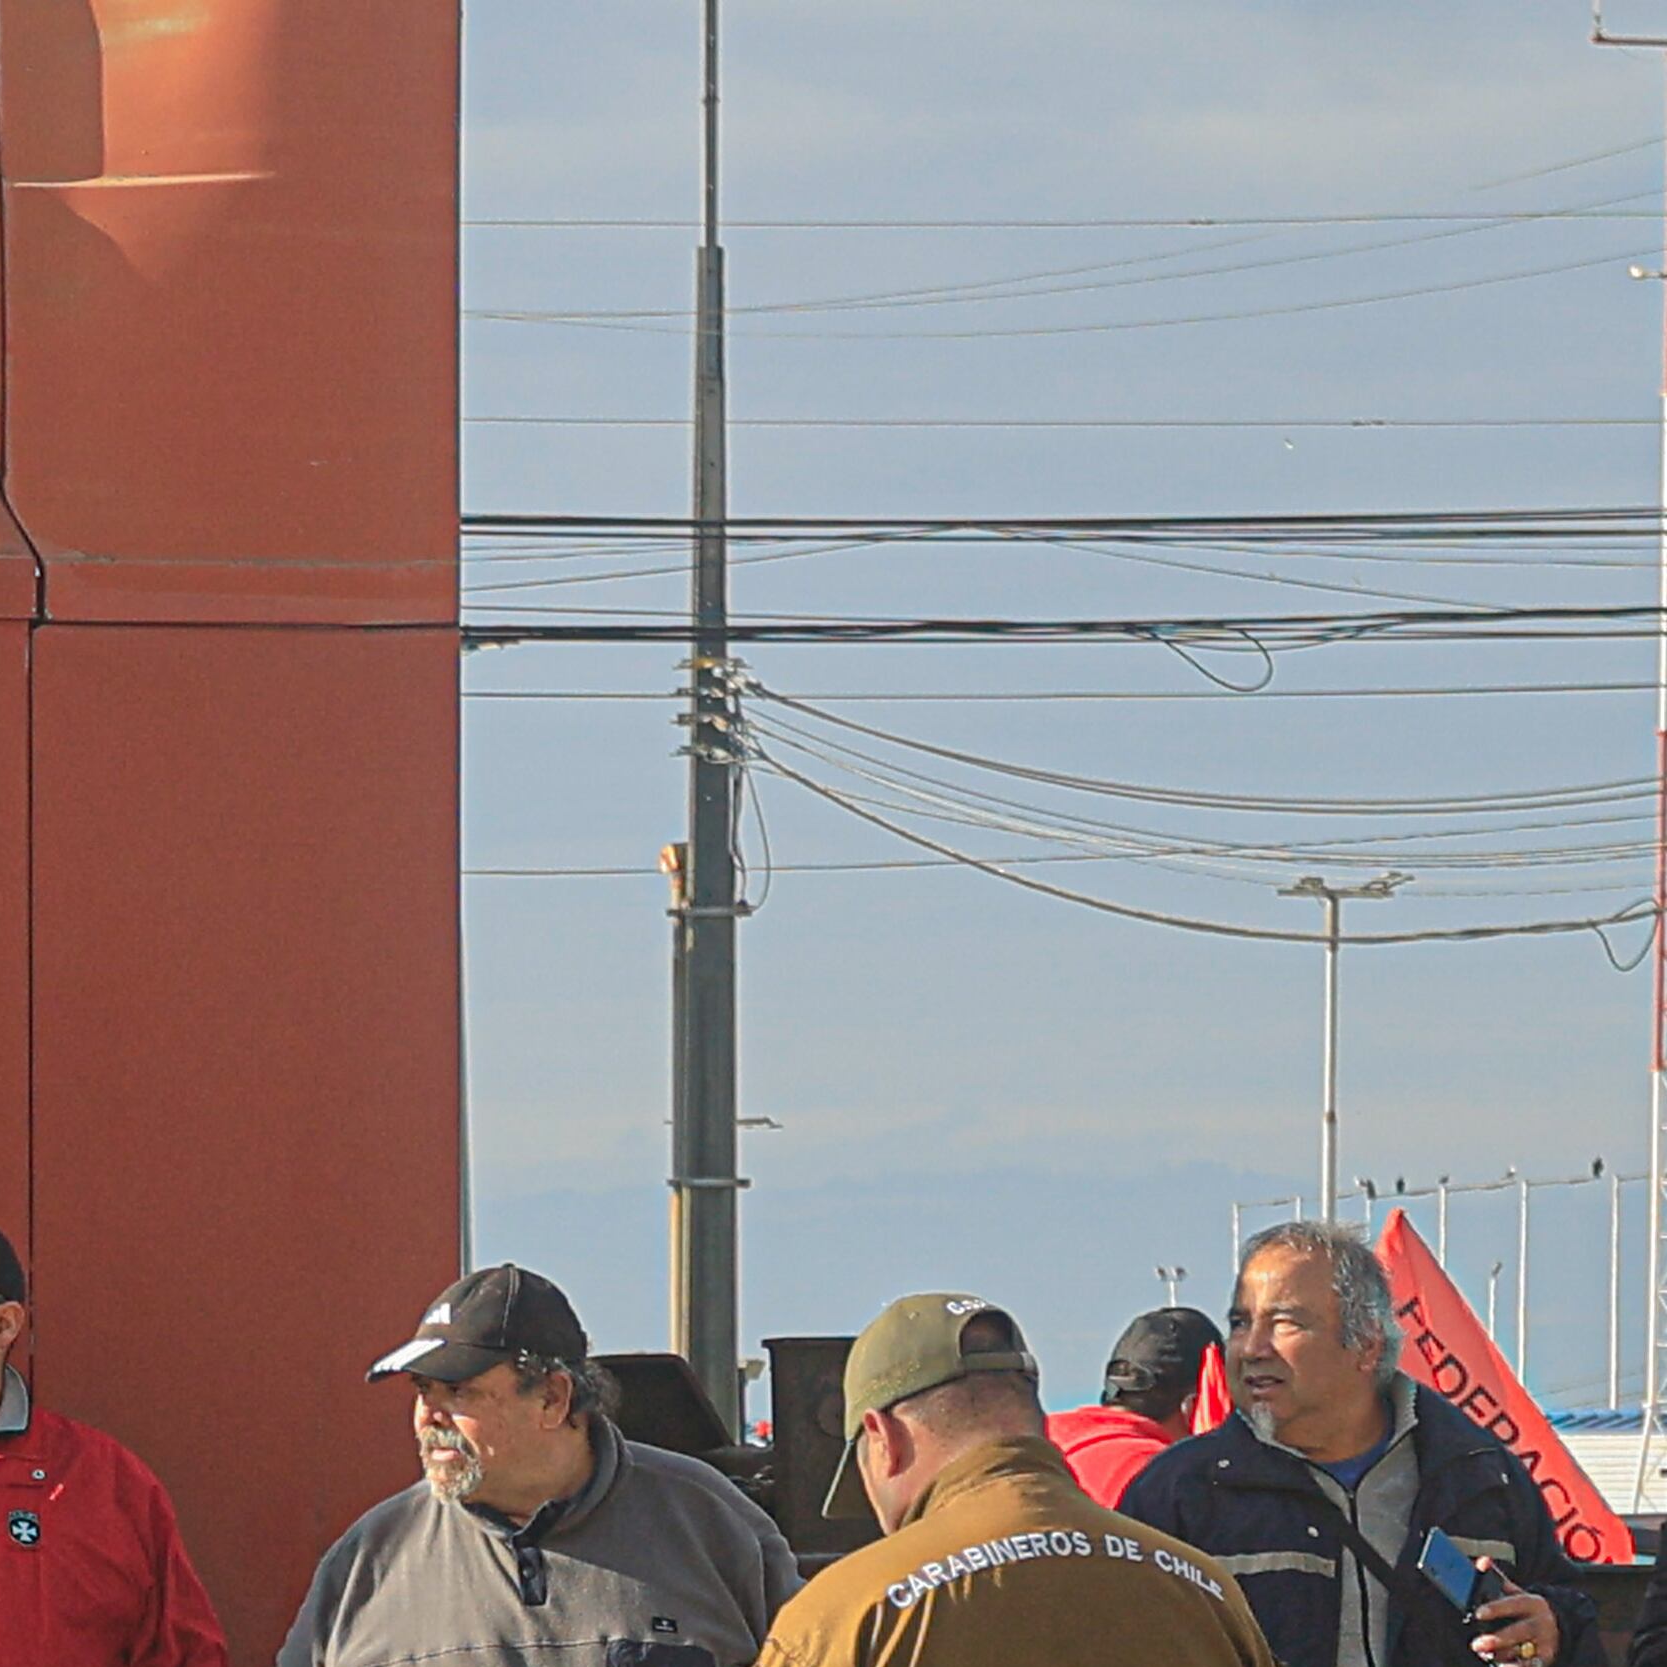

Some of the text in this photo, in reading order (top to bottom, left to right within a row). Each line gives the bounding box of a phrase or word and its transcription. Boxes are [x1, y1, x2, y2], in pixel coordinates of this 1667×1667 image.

[1398, 1296, 1613, 1563] FEDERACIÓ
[886, 1530, 1224, 1611] CARABINEROS DE CHILE
